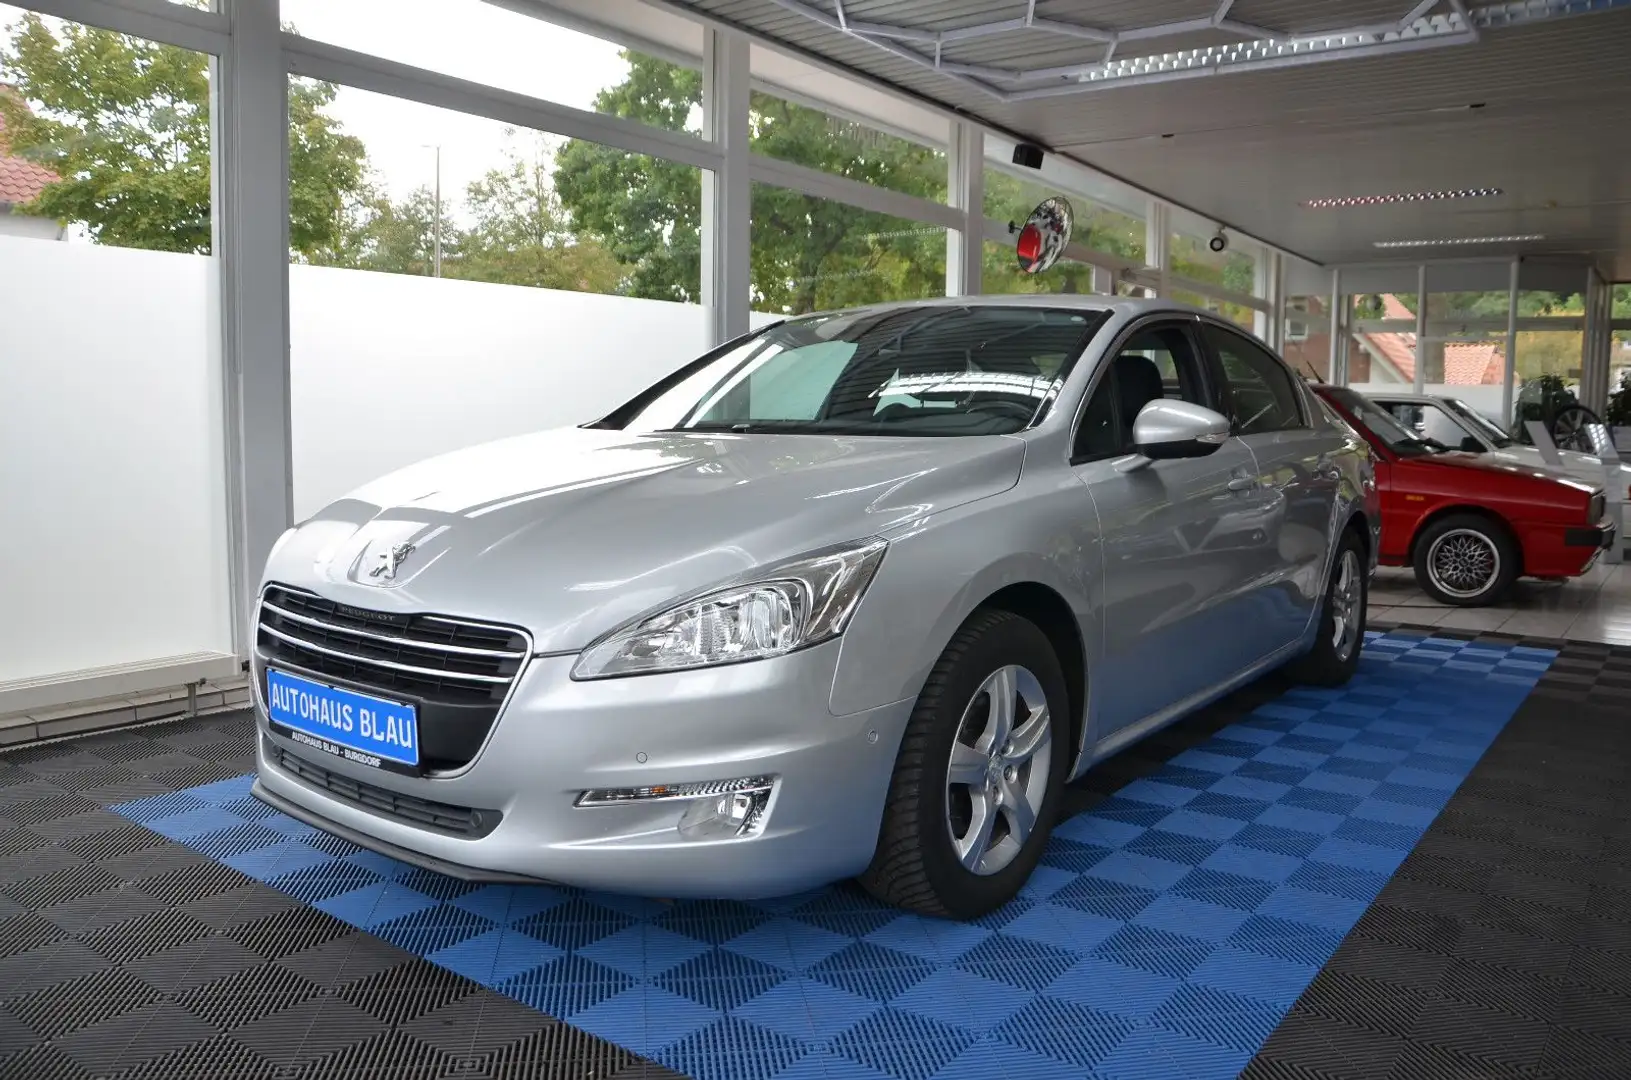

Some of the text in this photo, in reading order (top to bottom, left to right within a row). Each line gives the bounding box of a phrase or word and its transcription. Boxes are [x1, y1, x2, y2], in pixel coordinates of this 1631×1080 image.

[272, 682, 412, 748] AUTOHAUS BLAU
[291, 731, 322, 749] AUTOHAUS
[323, 741, 340, 755] BLAU
[344, 748, 381, 767] BURGDORF
